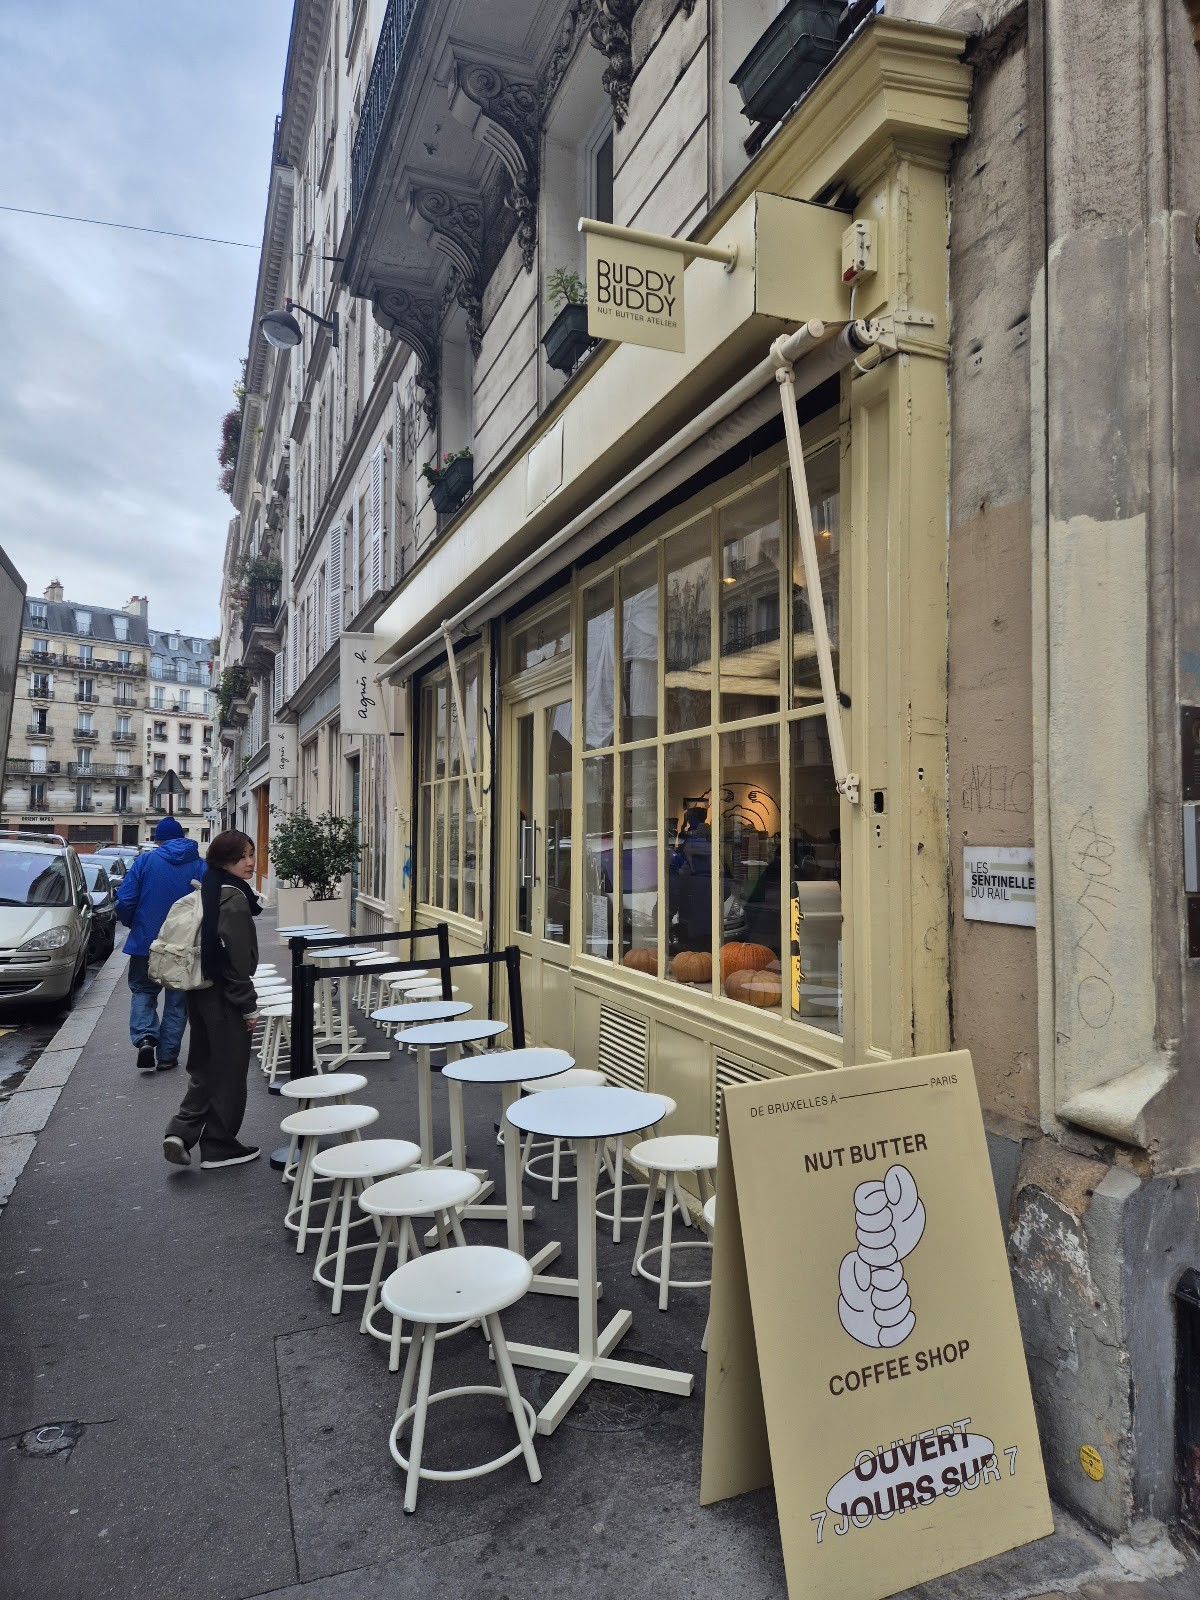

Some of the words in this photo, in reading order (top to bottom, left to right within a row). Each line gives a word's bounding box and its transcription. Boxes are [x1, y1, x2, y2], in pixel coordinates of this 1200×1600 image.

[597, 258, 676, 295] BUDDY
[597, 273, 676, 317] BUDDY
[597, 306, 612, 315] NUT
[616, 309, 644, 322] BUTTER
[646, 316, 677, 328] ATELIER
[970, 861, 989, 874] LES
[971, 874, 1035, 890] SENTINELLE
[971, 886, 985, 899] DU
[987, 887, 1010, 901] RAIL
[750, 1106, 765, 1118] DE
[767, 1096, 829, 1115] BRUXELLES
[830, 1094, 838, 1105] À
[930, 1074, 958, 1088] PARIS
[804, 1148, 846, 1173] NUT
[850, 1133, 928, 1165] BUTTER
[829, 1356, 912, 1396] COFFEE
[914, 1339, 970, 1372] SHOP
[853, 1417, 972, 1482] OUVERT
[810, 1510, 827, 1543] 7
[833, 1474, 937, 1536] JOURS
[941, 1453, 1001, 1497] SUR
[1003, 1445, 1018, 1476] 7
